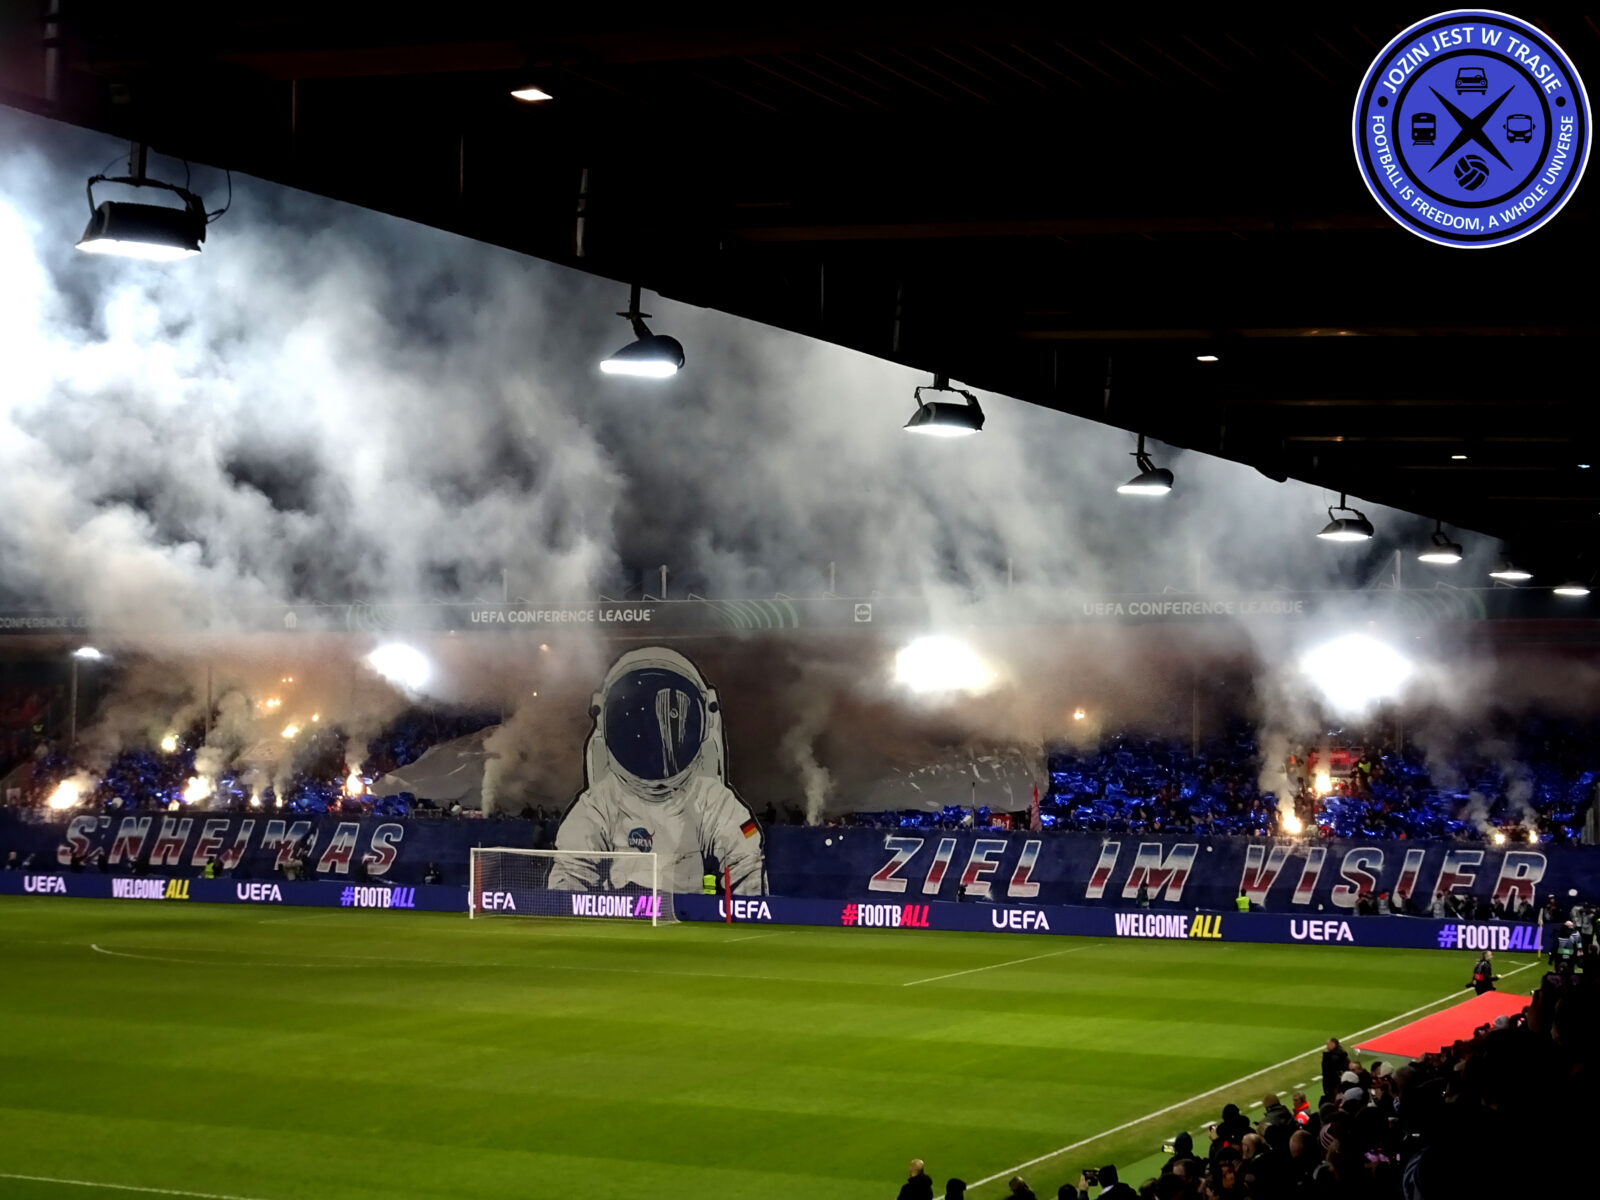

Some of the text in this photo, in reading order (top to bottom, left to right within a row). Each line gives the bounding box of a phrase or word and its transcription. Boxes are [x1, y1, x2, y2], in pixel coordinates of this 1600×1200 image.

[471, 609, 651, 623] UEFA CONFERENCE LEAGUE
[1083, 602, 1124, 616] UEFA
[1128, 601, 1234, 616] CONFERENCE
[24, 875, 67, 893] UEFA
[868, 836, 1547, 912] ZIEL IM VISIER
[112, 878, 190, 899] WELCOME ALL
[237, 882, 282, 902] UEFA
[341, 886, 415, 908] #FOOTBALL
[572, 894, 634, 917] WELCOME
[719, 899, 772, 920] UEFA
[841, 903, 930, 927] #FOOTBALL
[992, 908, 1050, 930] UEFA
[1115, 913, 1222, 938] WELCOME ALL
[1290, 919, 1354, 942] UEFA
[1437, 924, 1543, 950] #FOOTBALL
